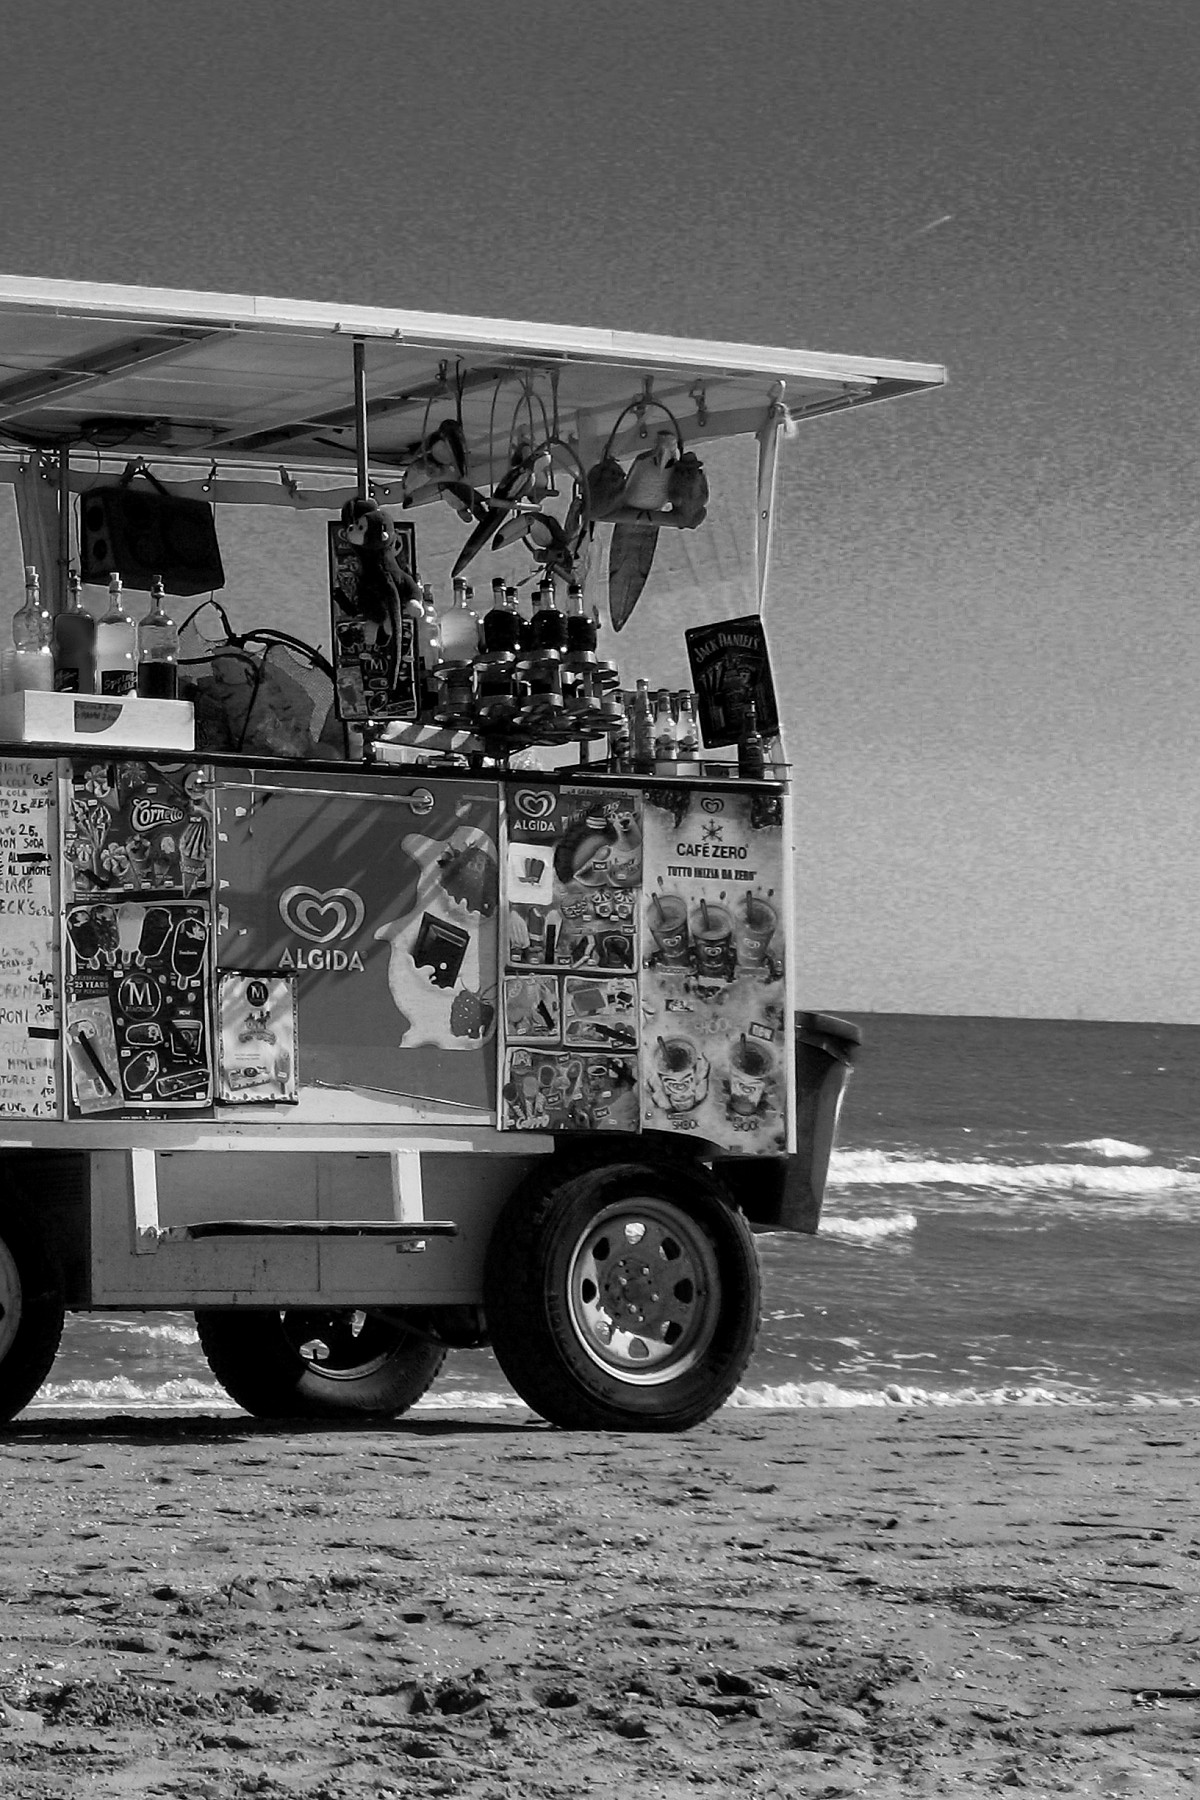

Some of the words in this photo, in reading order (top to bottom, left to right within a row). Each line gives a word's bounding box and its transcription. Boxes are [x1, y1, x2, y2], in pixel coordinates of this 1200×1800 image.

[694, 639, 719, 663] JACK
[6, 789, 28, 797] COLA
[131, 798, 185, 832] Cornetto
[513, 819, 556, 832] ALGIDA
[23, 838, 44, 849] SODA
[676, 843, 710, 857] CAFÉ
[711, 845, 747, 860] ZERO
[7, 865, 19, 876] AL
[22, 865, 52, 876] LIMONE
[667, 866, 692, 878] TUTTO
[278, 948, 365, 973] ALGIDA
[85, 981, 109, 989] YEARS
[125, 979, 153, 1005] M
[250, 984, 265, 999] M
